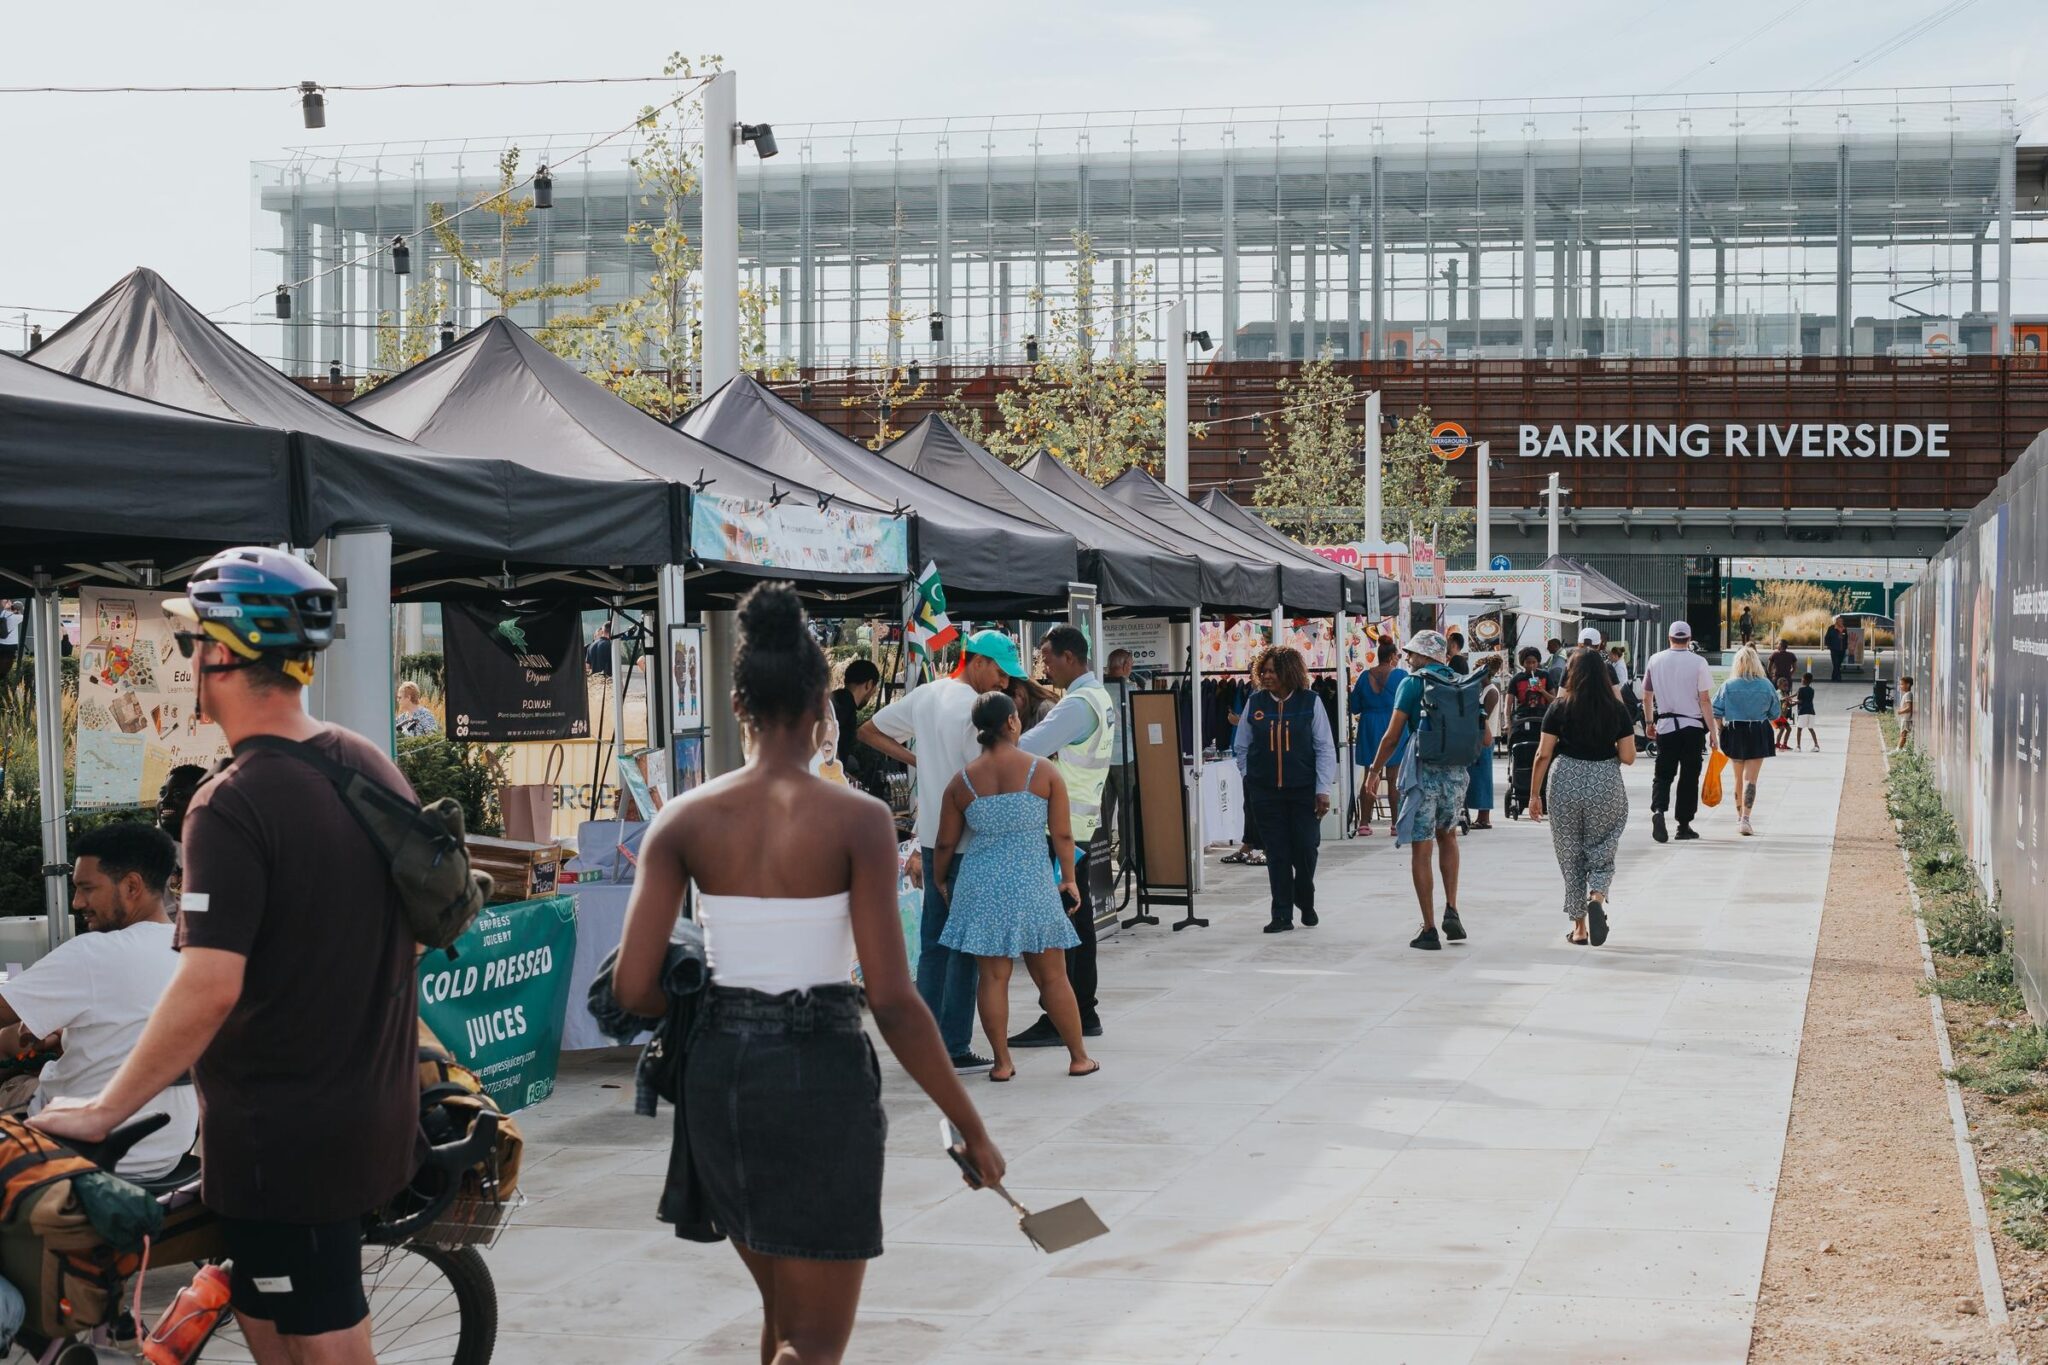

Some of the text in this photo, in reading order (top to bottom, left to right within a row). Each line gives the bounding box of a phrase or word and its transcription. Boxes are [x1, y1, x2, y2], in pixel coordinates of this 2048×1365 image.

[1518, 423, 1950, 458] BARKING RIVERSIDE
[479, 915, 511, 932] EMPRESS
[422, 946, 552, 1004] COLD PRESSED
[466, 1005, 527, 1057] JUICES
